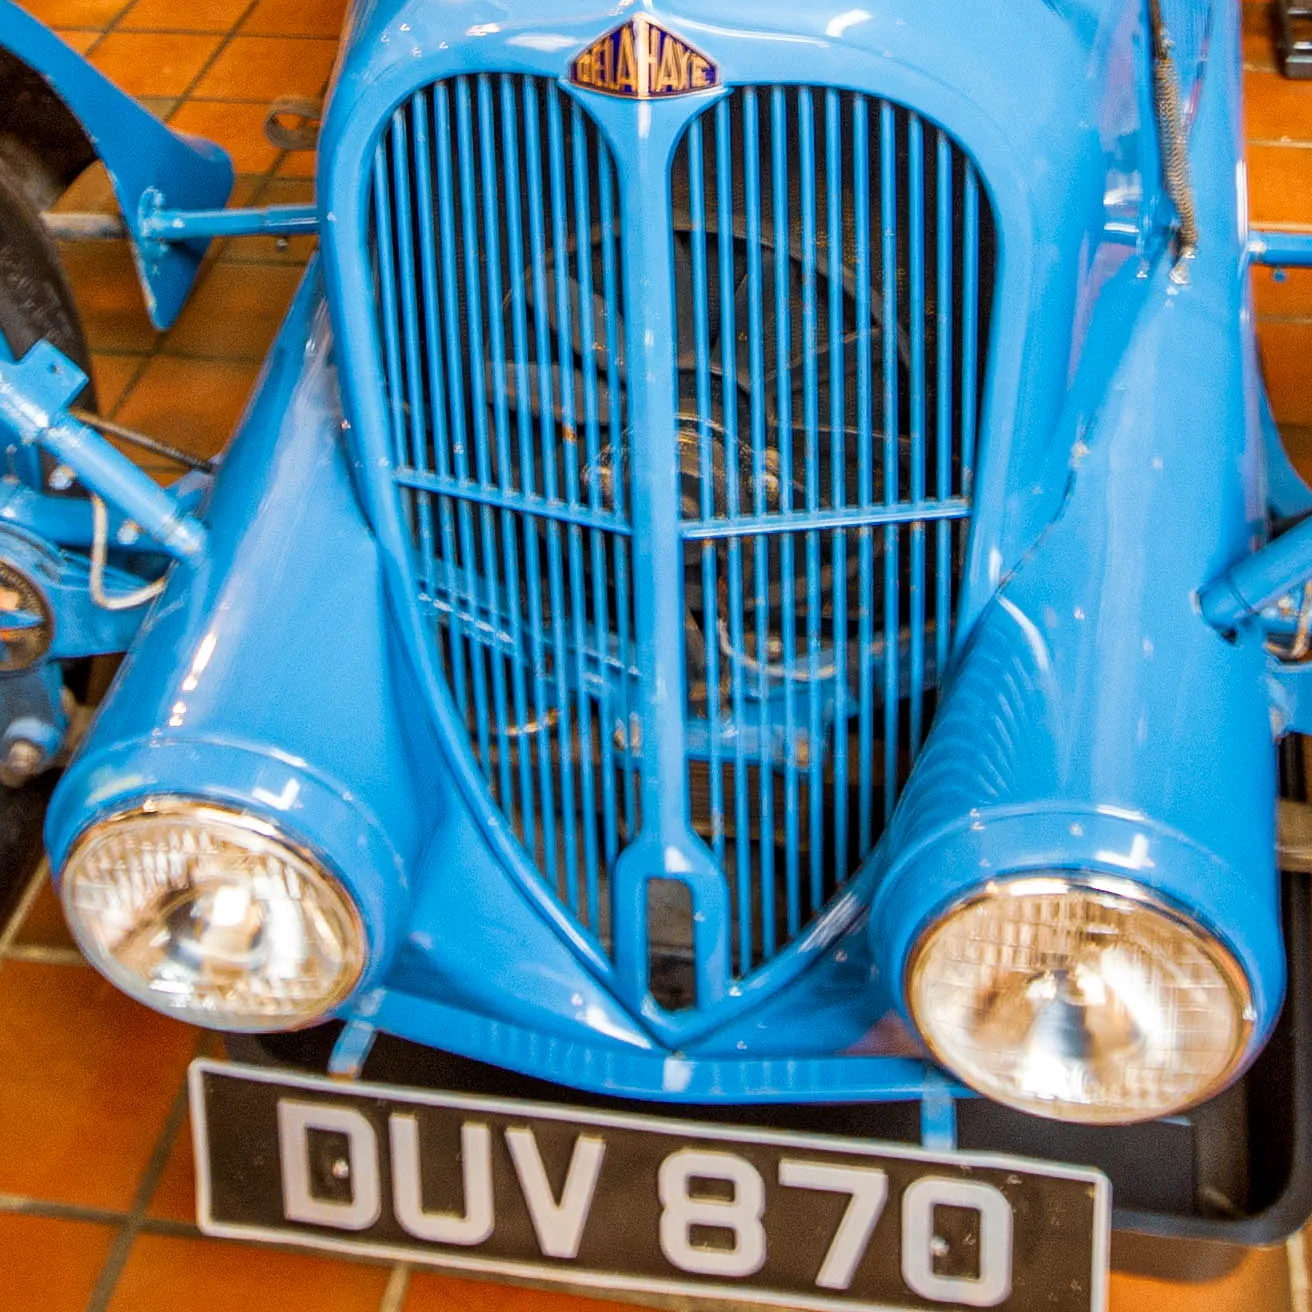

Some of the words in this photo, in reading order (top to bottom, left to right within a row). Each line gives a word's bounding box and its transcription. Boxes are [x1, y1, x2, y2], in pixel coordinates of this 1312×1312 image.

[576, 23, 712, 94] DELAHAYE
[277, 1097, 606, 1259] DUV
[658, 1149, 1014, 1307] 870
